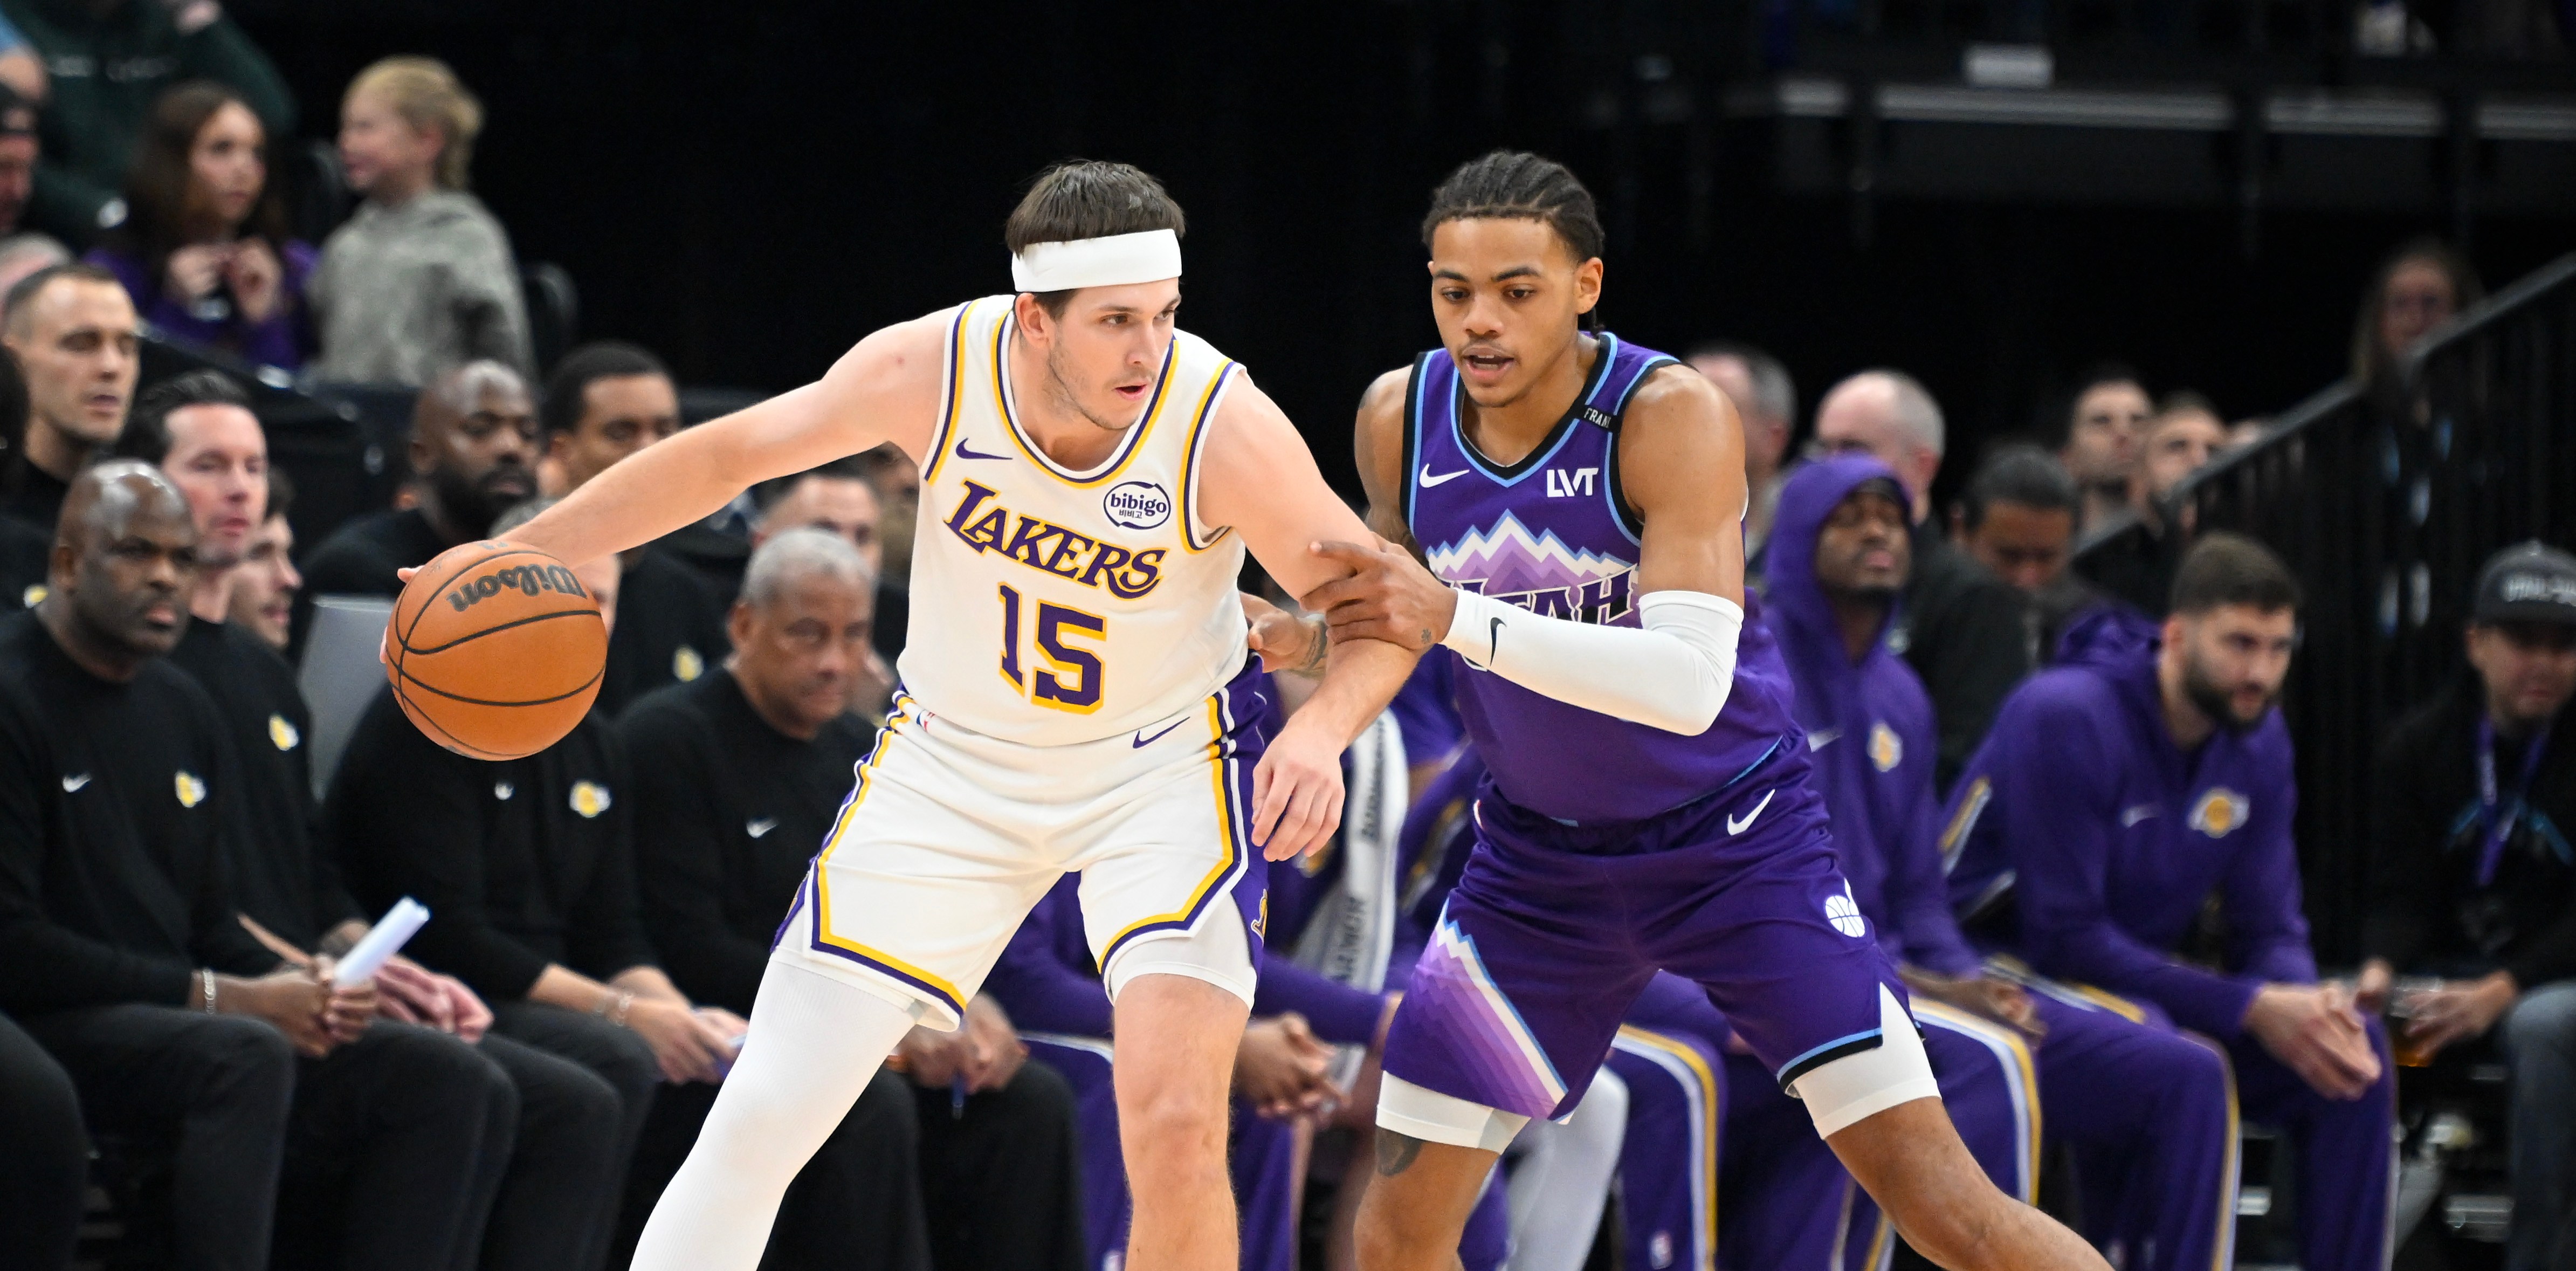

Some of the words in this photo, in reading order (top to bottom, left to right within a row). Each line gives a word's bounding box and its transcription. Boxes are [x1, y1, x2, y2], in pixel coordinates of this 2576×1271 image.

[1546, 468, 1599, 497] LVT
[1111, 493, 1167, 517] bibigo
[1119, 509, 1142, 519] 비비고
[943, 478, 1169, 600] LAKERS
[446, 564, 588, 612] Wilson
[998, 581, 1107, 714] 15
